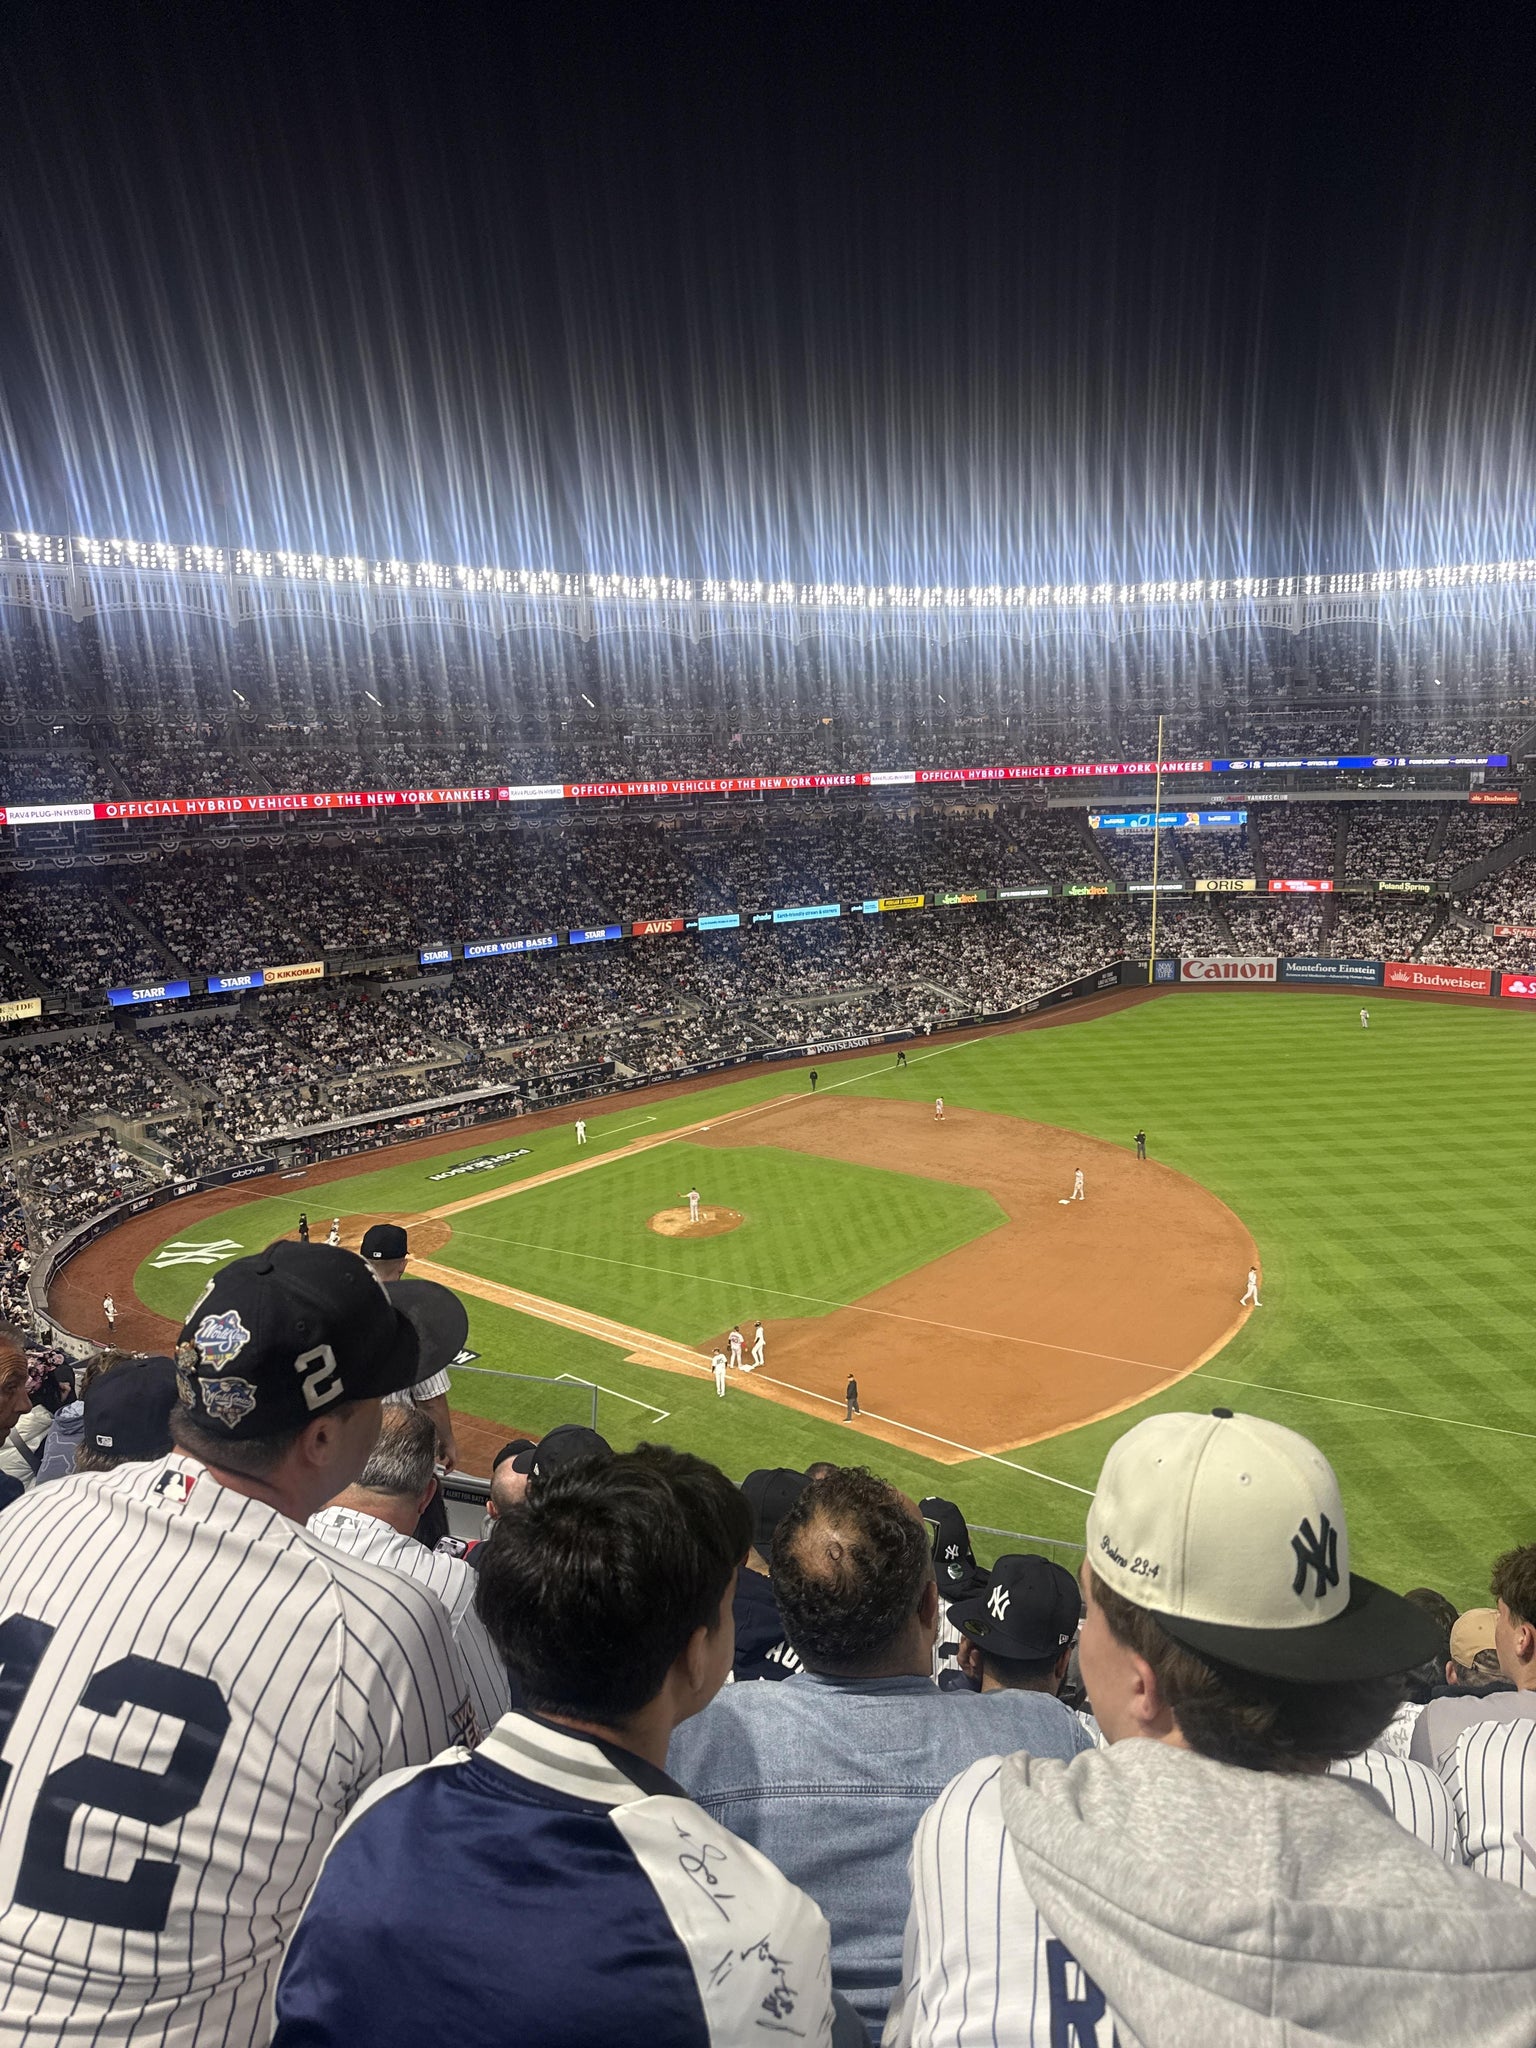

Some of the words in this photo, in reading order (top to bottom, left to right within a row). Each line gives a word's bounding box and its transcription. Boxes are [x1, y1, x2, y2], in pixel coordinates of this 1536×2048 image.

[921, 770, 965, 780] OFFICIAL
[968, 769, 1005, 779] HYBRID
[1008, 766, 1050, 777] VEHICLE
[1054, 766, 1067, 775] OF
[1071, 765, 1091, 774] THE
[1095, 764, 1118, 774] NEW
[1122, 763, 1151, 773] YORK
[1155, 761, 1204, 772] YANKEES
[571, 785, 624, 796] OFFICIAL
[628, 782, 668, 793] HYBRID
[672, 781, 716, 791] VEHICLE
[720, 780, 733, 790] OF
[737, 779, 756, 788] THE
[760, 778, 782, 788] NEW
[786, 777, 811, 787] YORK
[814, 775, 856, 785] YANKEES
[106, 804, 180, 816] OFFICIAL
[186, 799, 242, 812] HYBRID
[248, 797, 307, 809] VEHICLE
[313, 795, 331, 806] OF
[336, 794, 361, 805] THE
[367, 792, 396, 804] NEW
[400, 791, 434, 803] YORK
[438, 789, 491, 800] YANKEES
[9, 811, 30, 819] RAV4
[30, 810, 63, 818] PLUG-IN
[63, 808, 91, 817] HYBRID
[1206, 880, 1244, 890] ORIS
[1379, 881, 1404, 890] Poland
[1404, 882, 1431, 892] Spring
[584, 929, 606, 939] STARR
[644, 921, 672, 934] AVIS
[469, 943, 498, 955] COVER
[500, 940, 524, 950] YOUR
[526, 936, 553, 947] BASES
[423, 950, 449, 961] STARR
[277, 966, 321, 979] KIKKOMAN
[1182, 960, 1274, 979] Canon
[1285, 962, 1337, 972] Montefiore
[1339, 964, 1376, 974] Einstein
[220, 975, 251, 988] STARR
[132, 987, 166, 1000] STARR
[816, 1038, 870, 1054] POSTSEASON
[651, 1073, 672, 1082] abbvie
[231, 1165, 266, 1179] abbvie
[186, 1182, 198, 1192] APP
[294, 1343, 345, 1411] 2
[945, 1544, 959, 1560] NY
[1291, 1512, 1340, 1598] NY
[1130, 1556, 1160, 1579] 23:4
[987, 1584, 1011, 1621] NY
